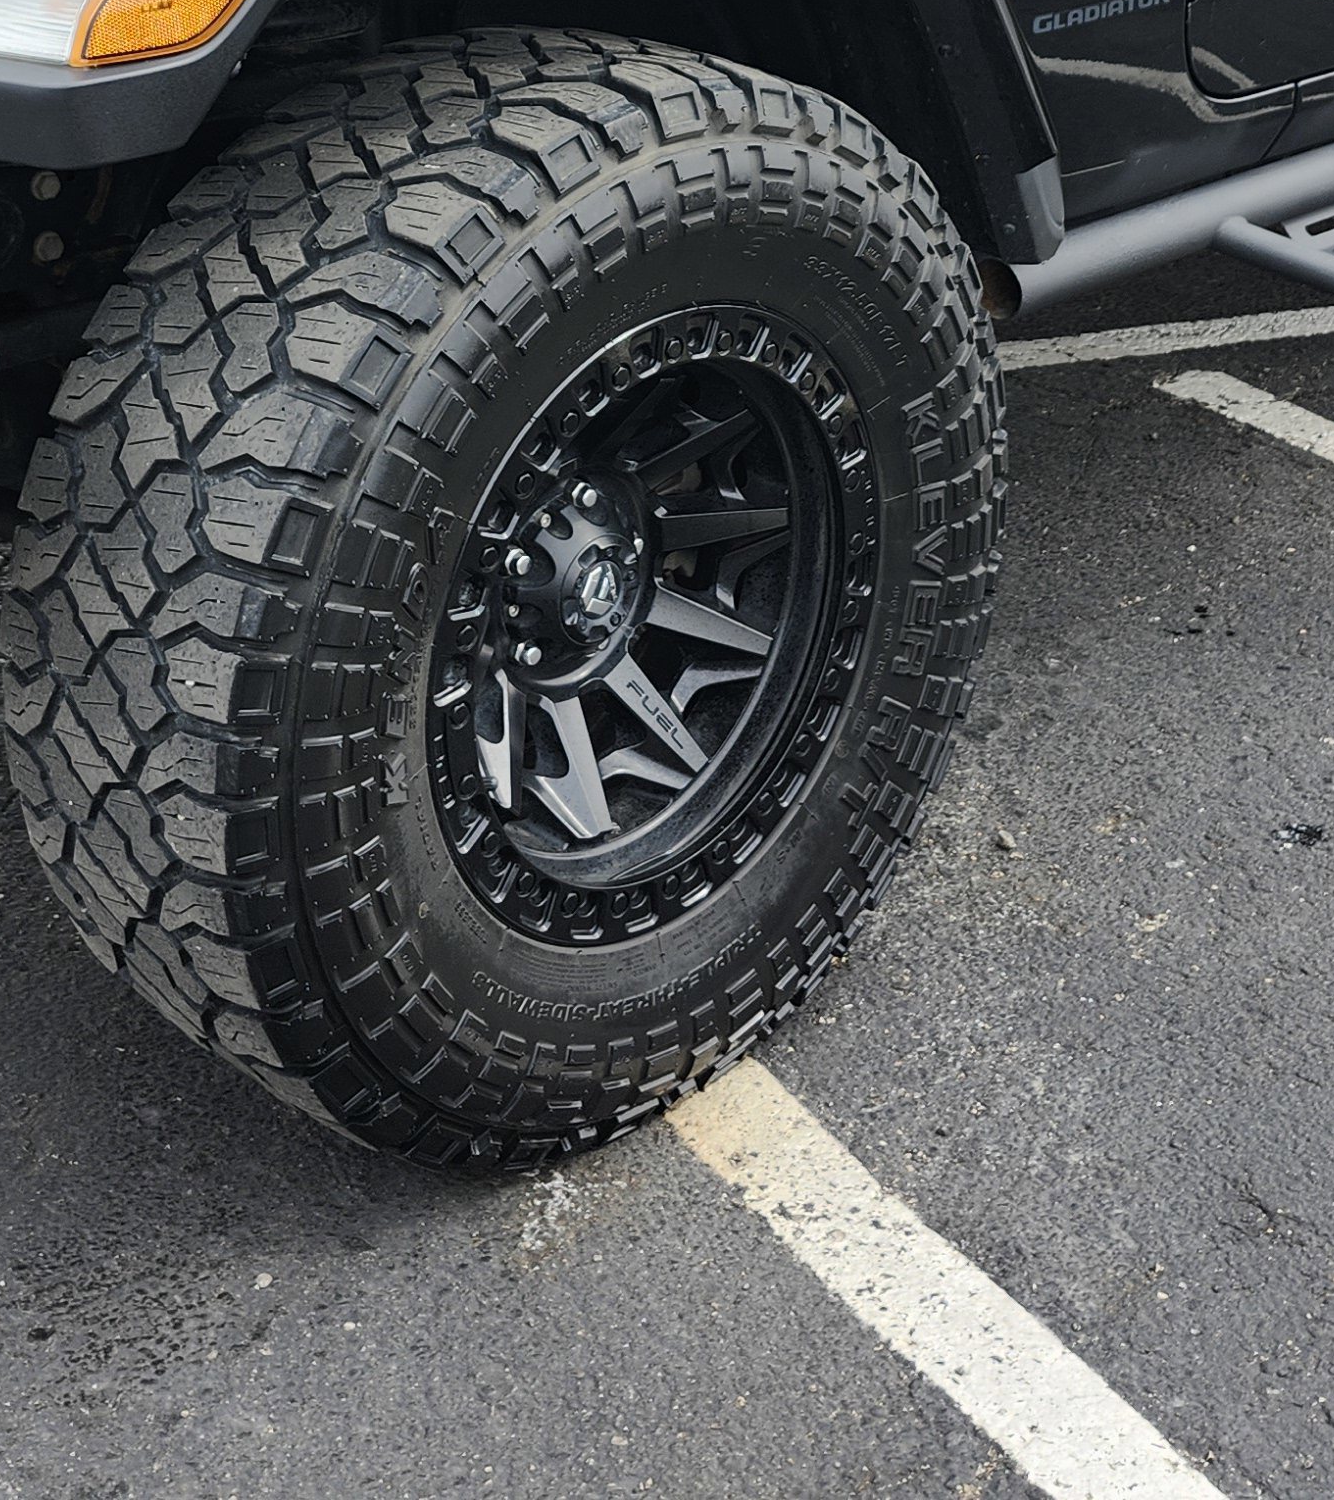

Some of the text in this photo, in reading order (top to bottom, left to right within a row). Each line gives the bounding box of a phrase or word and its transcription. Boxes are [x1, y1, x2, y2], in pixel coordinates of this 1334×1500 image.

[891, 390, 948, 676] KLEVER
[379, 505, 456, 805] KENDA
[626, 680, 684, 750] FUEL
[838, 695, 913, 830] R/T
